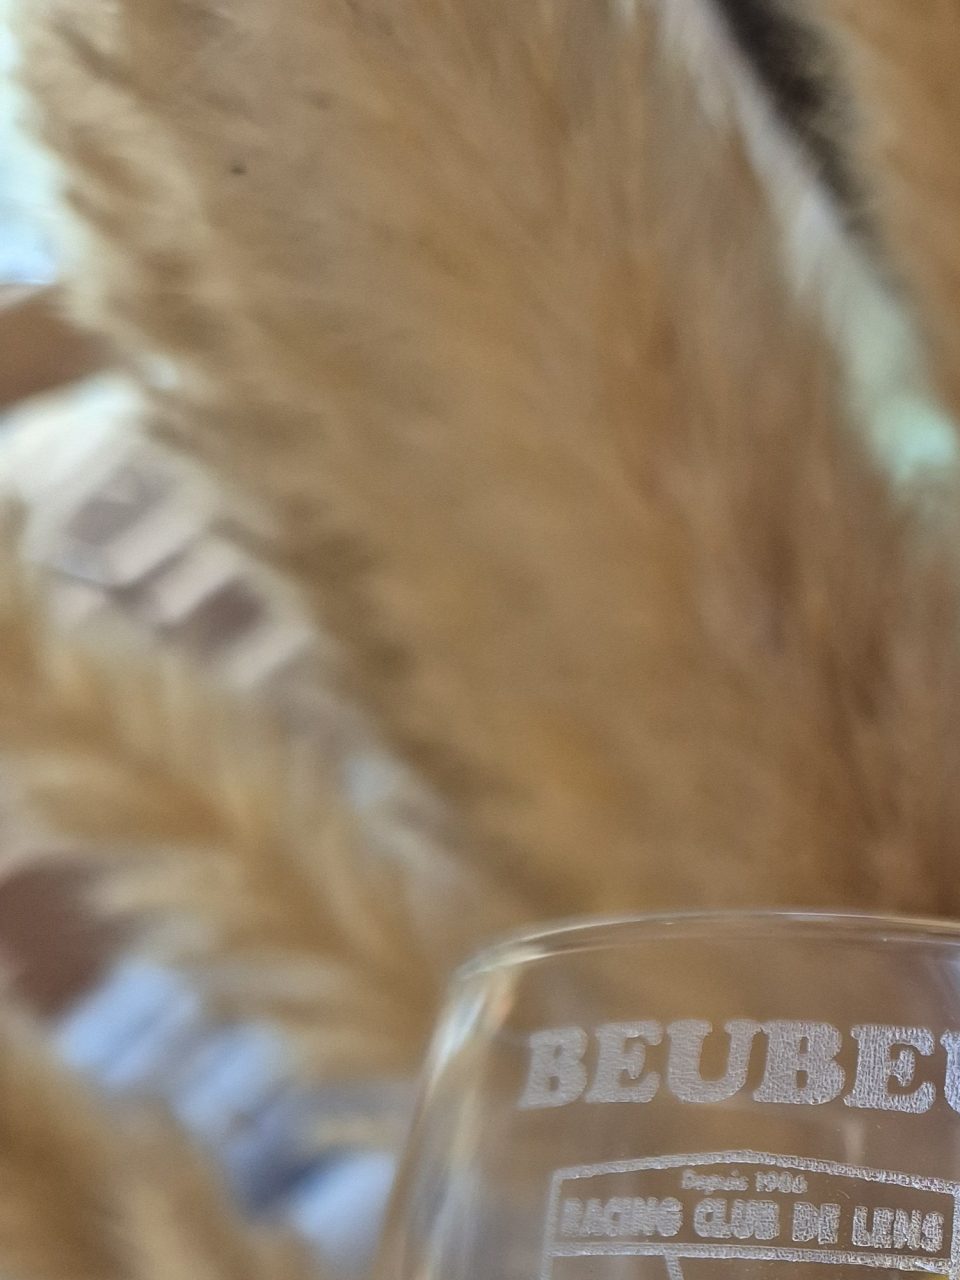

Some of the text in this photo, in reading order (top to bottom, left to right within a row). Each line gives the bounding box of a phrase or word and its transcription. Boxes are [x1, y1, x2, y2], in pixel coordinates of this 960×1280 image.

[560, 1196, 946, 1253] RACING CLUB DE LENS
